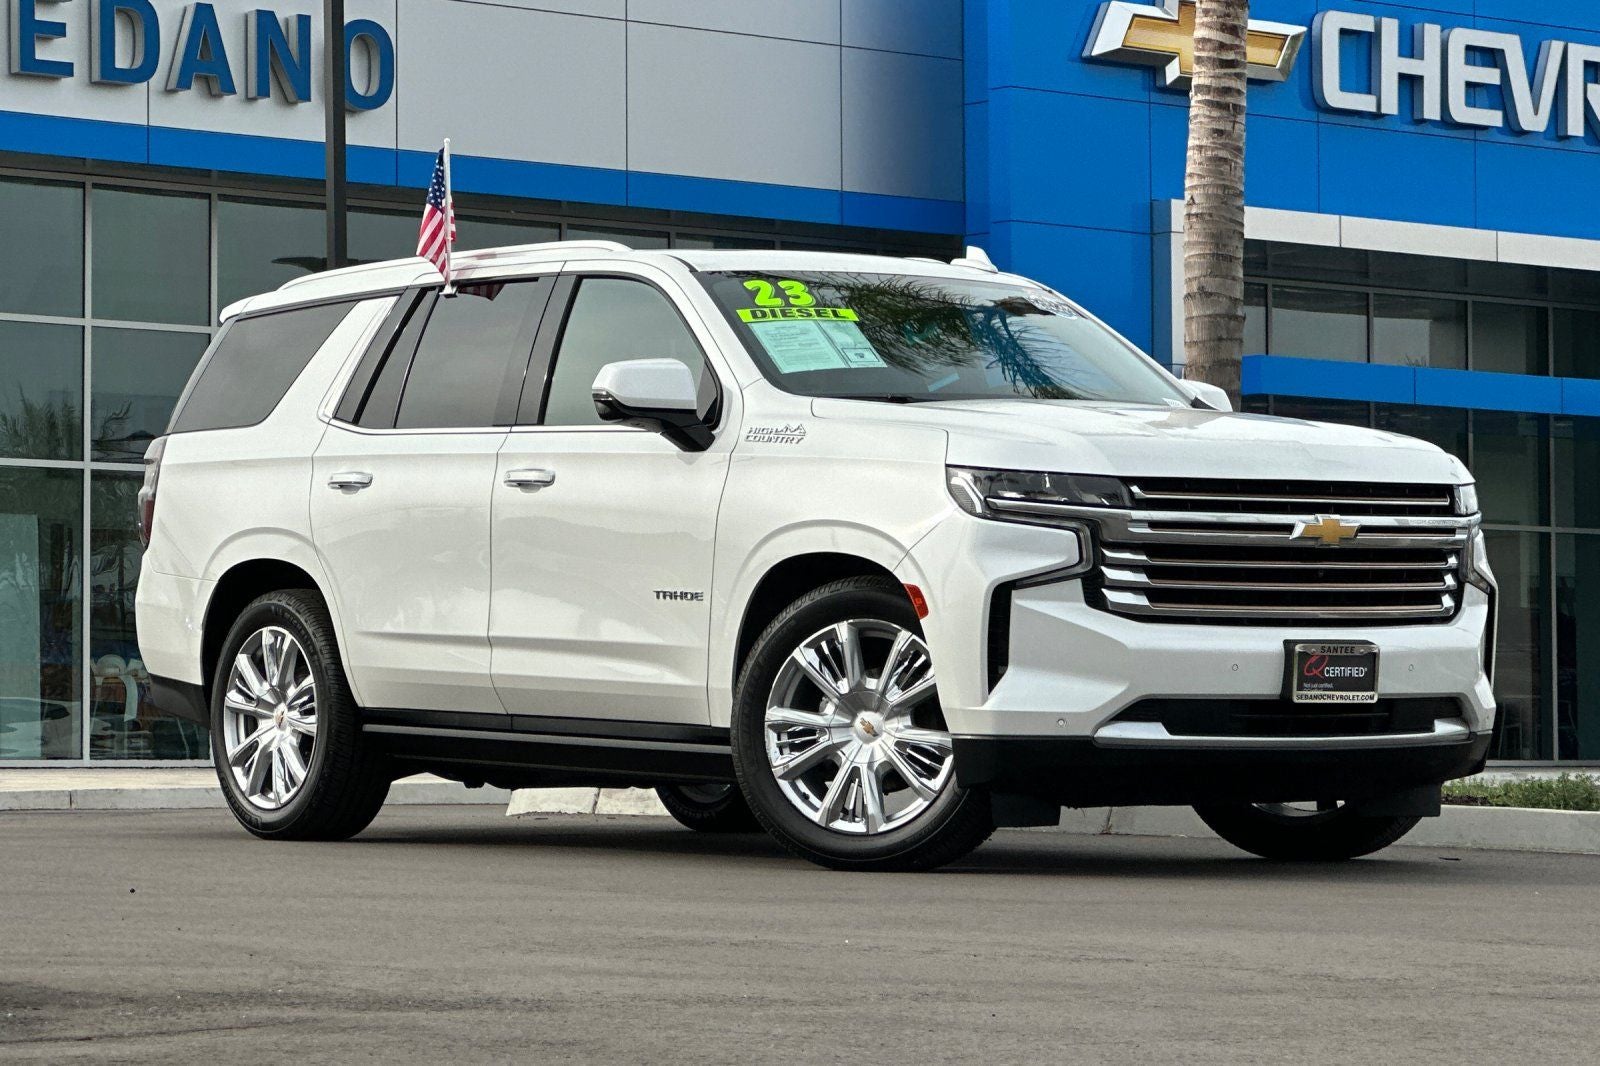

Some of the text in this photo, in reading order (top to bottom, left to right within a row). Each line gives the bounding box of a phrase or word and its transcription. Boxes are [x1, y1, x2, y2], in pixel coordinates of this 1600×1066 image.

[743, 279, 815, 307] 23
[751, 308, 849, 320] DIESEL
[745, 434, 805, 444] COUNTRY
[653, 590, 704, 601] TAHOE
[1320, 646, 1355, 654] SANTEE
[1324, 666, 1366, 678] CERTIFIED
